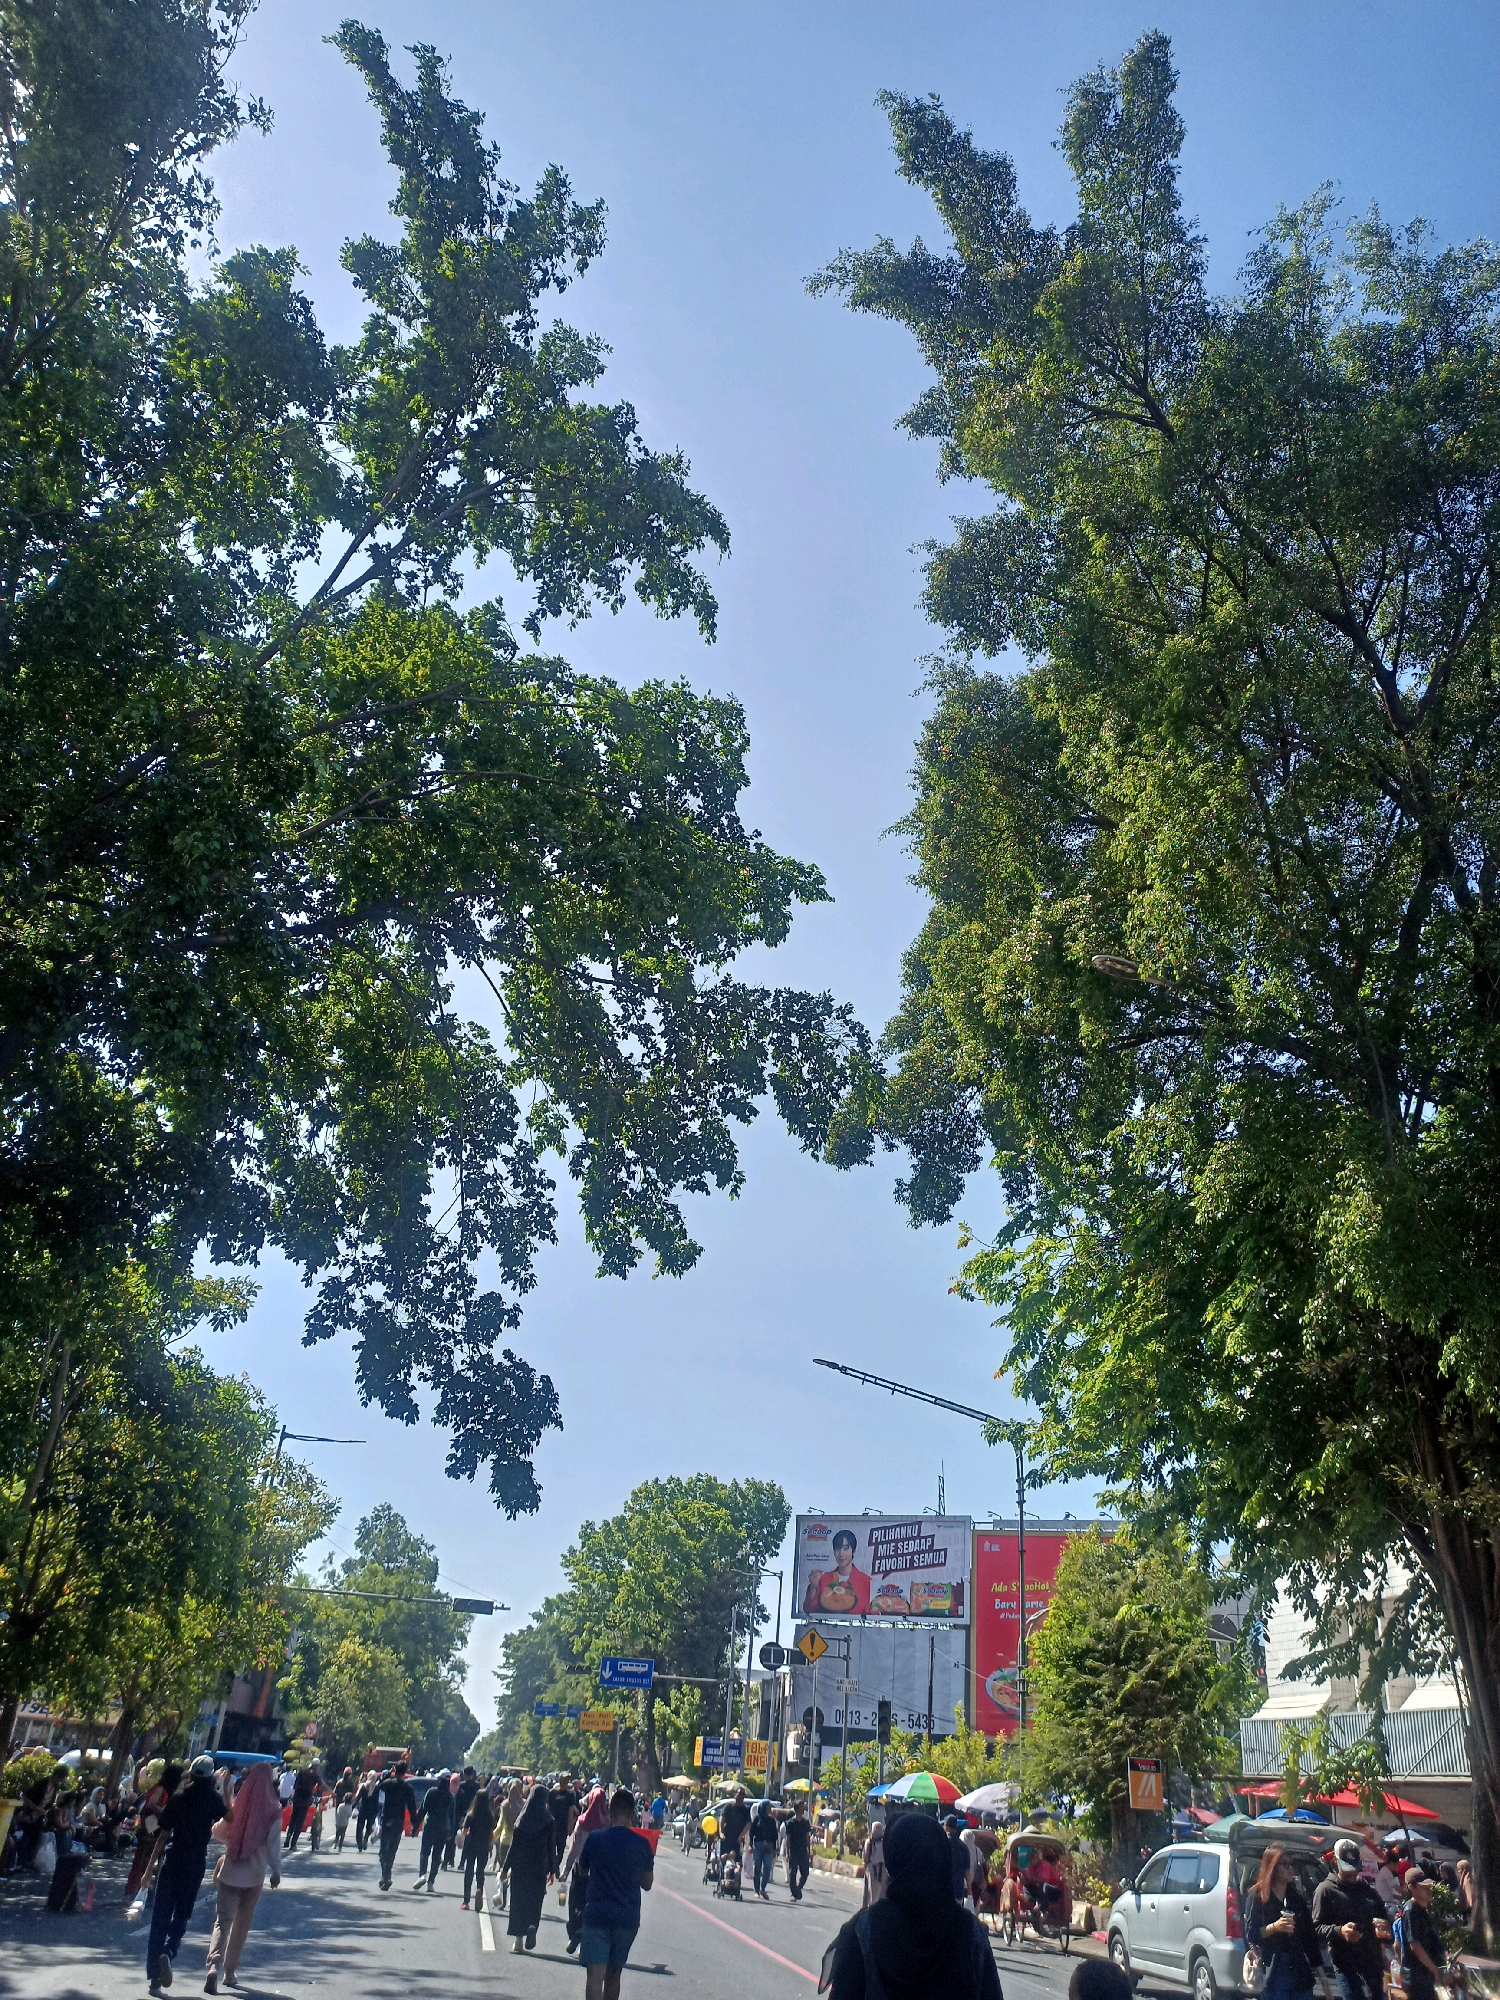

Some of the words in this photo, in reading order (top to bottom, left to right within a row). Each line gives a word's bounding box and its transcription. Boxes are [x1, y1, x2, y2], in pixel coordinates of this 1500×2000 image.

[872, 1524, 919, 1543] PILIHANKU
[878, 1543, 895, 1557] MIE
[897, 1537, 932, 1554] SEDAAP
[874, 1555, 912, 1572] FAVORIT
[913, 1551, 945, 1567] SEMUA
[991, 1582, 1008, 1592] Ada
